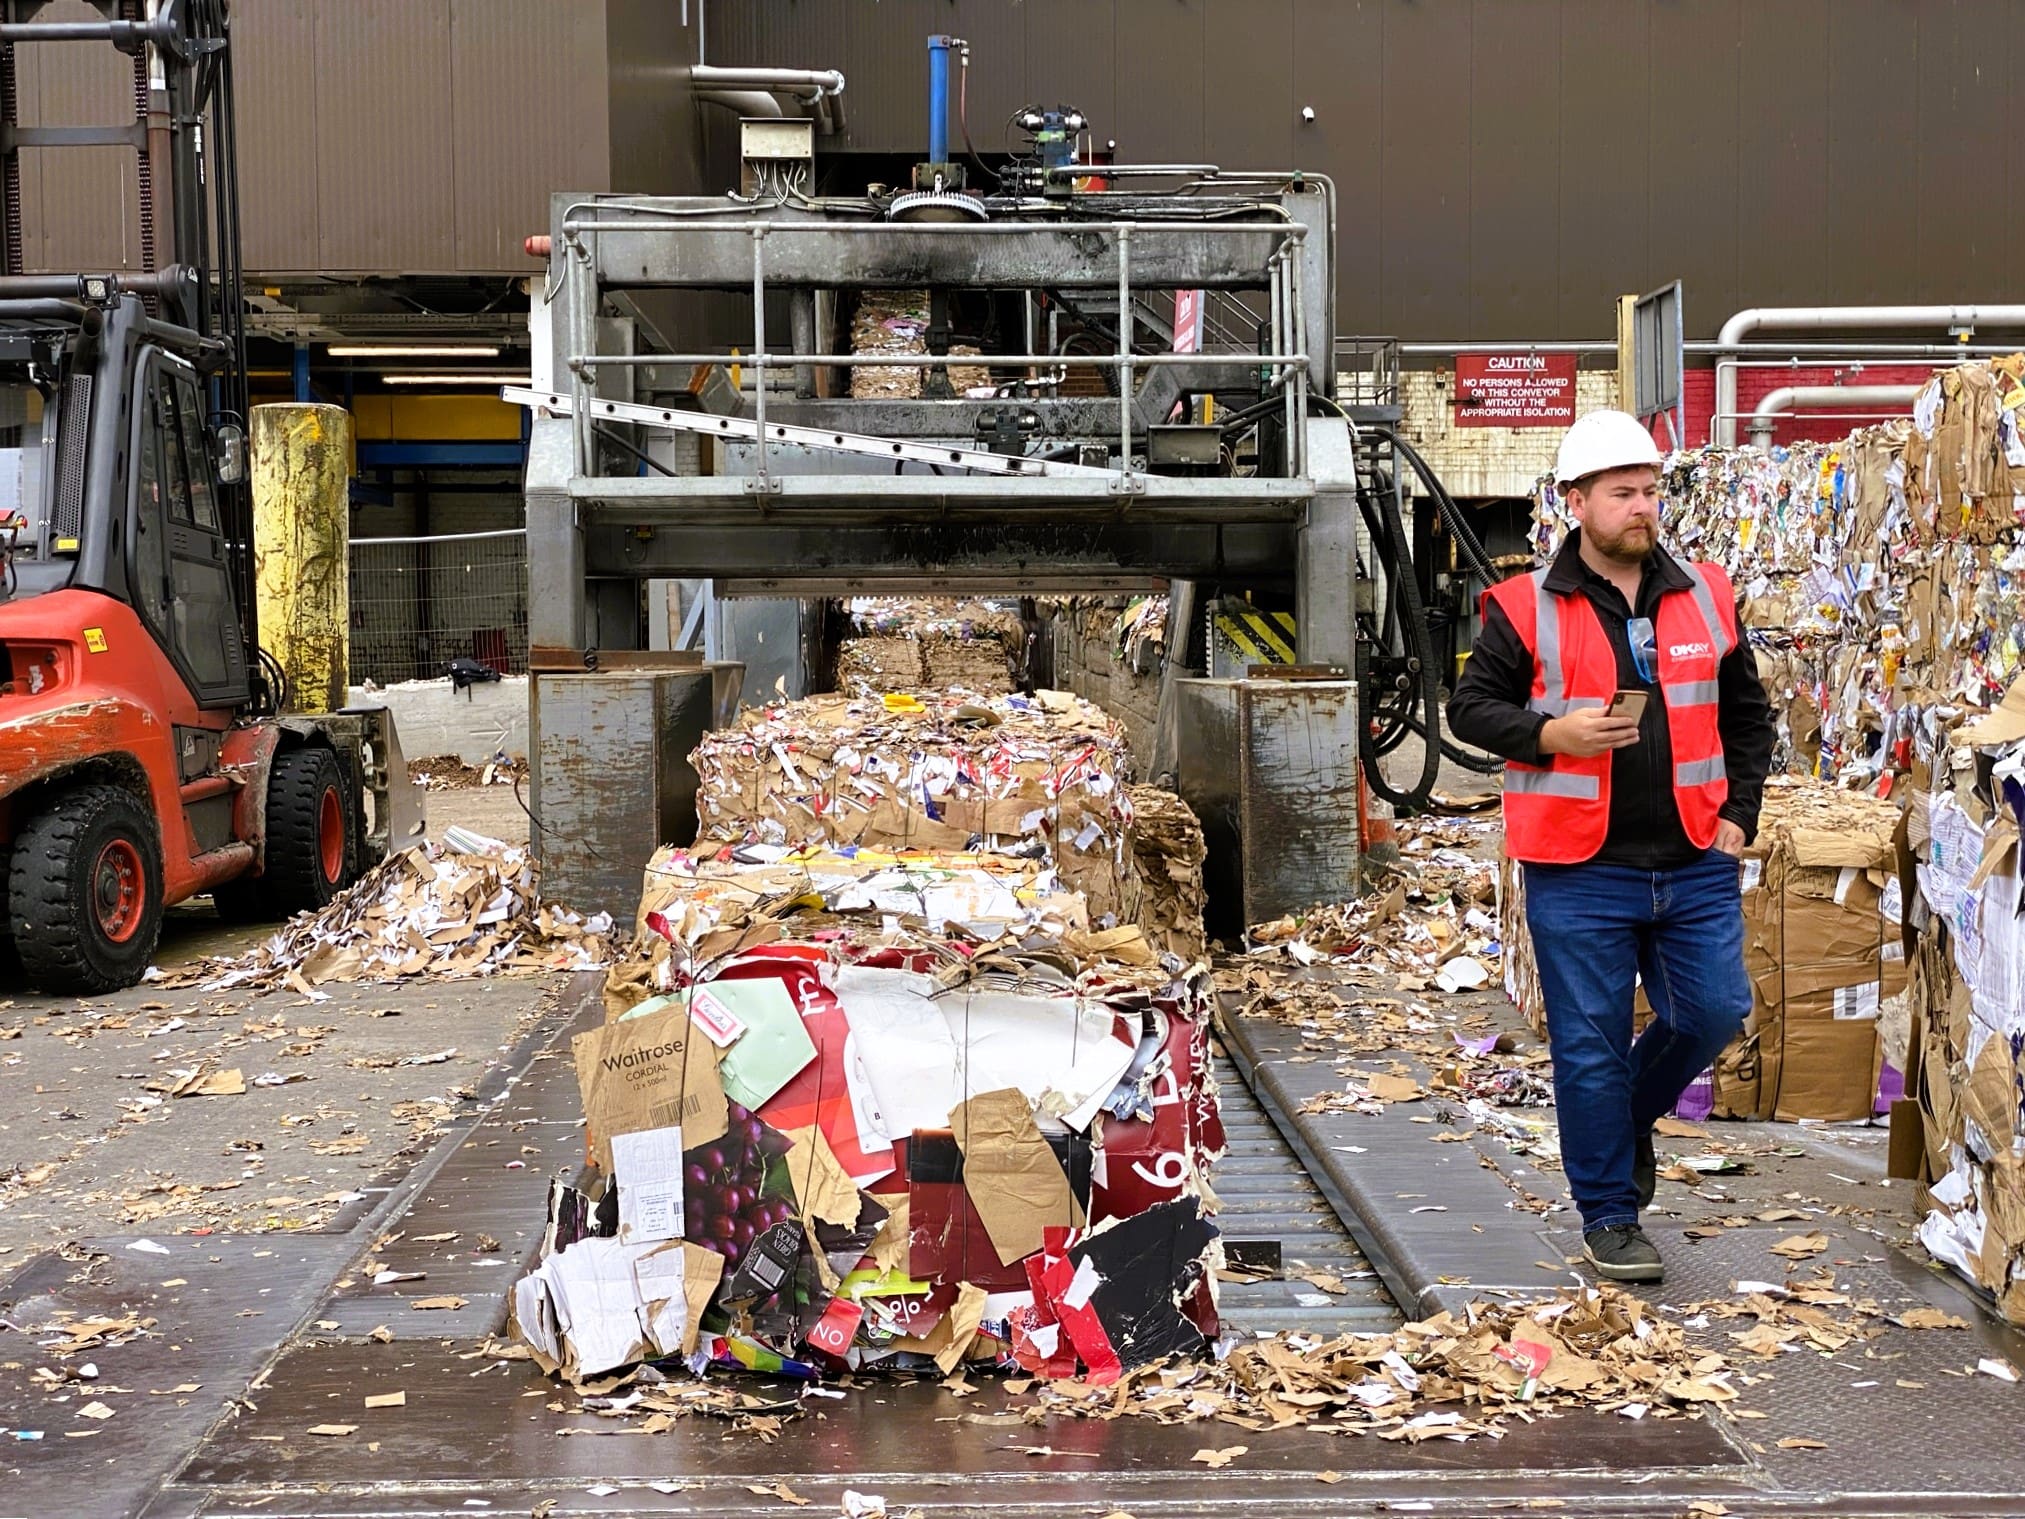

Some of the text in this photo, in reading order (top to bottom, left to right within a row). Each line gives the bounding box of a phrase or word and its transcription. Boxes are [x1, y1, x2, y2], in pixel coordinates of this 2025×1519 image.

[1488, 357, 1545, 369] CAUTION
[1463, 378, 1477, 387] NO
[1480, 378, 1522, 387] PERSONS
[1471, 388, 1560, 397] ON THIS CONVEYOR
[1484, 398, 1546, 407] WITHOUT THE
[1460, 407, 1571, 417] APPROPRIATE ISOLATION
[1669, 643, 1710, 657] OKAY
[602, 1040, 684, 1072] Waitrose
[625, 1062, 669, 1082] CORDIAL
[813, 1321, 843, 1345] NO
